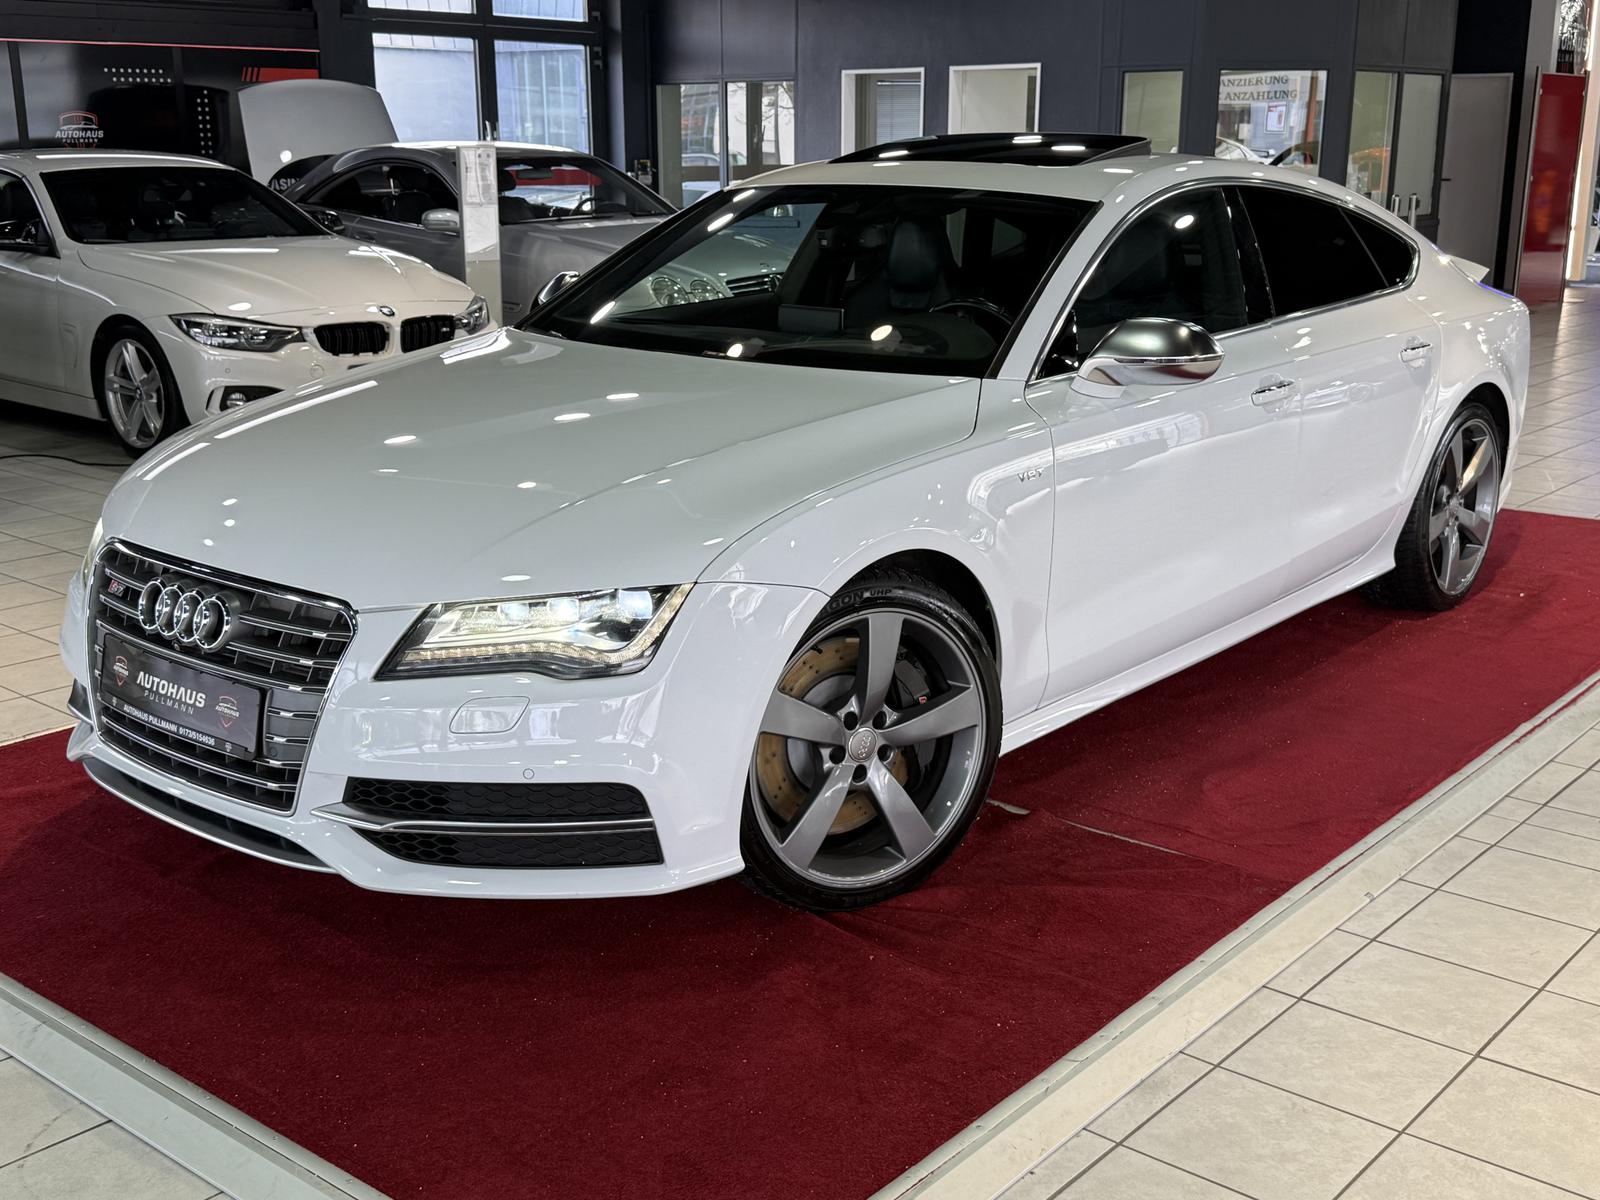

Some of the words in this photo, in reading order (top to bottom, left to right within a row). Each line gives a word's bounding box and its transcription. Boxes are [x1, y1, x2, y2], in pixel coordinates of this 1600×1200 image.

[1224, 89, 1297, 101] ANZAHLUNG
[55, 130, 104, 138] AUTOHAUS
[870, 588, 892, 597] UHP
[136, 671, 207, 708] AUTOHAUS
[143, 689, 195, 715] PULLMANN
[123, 703, 153, 723] AUTOHAUS
[148, 715, 178, 733] PULLMANN
